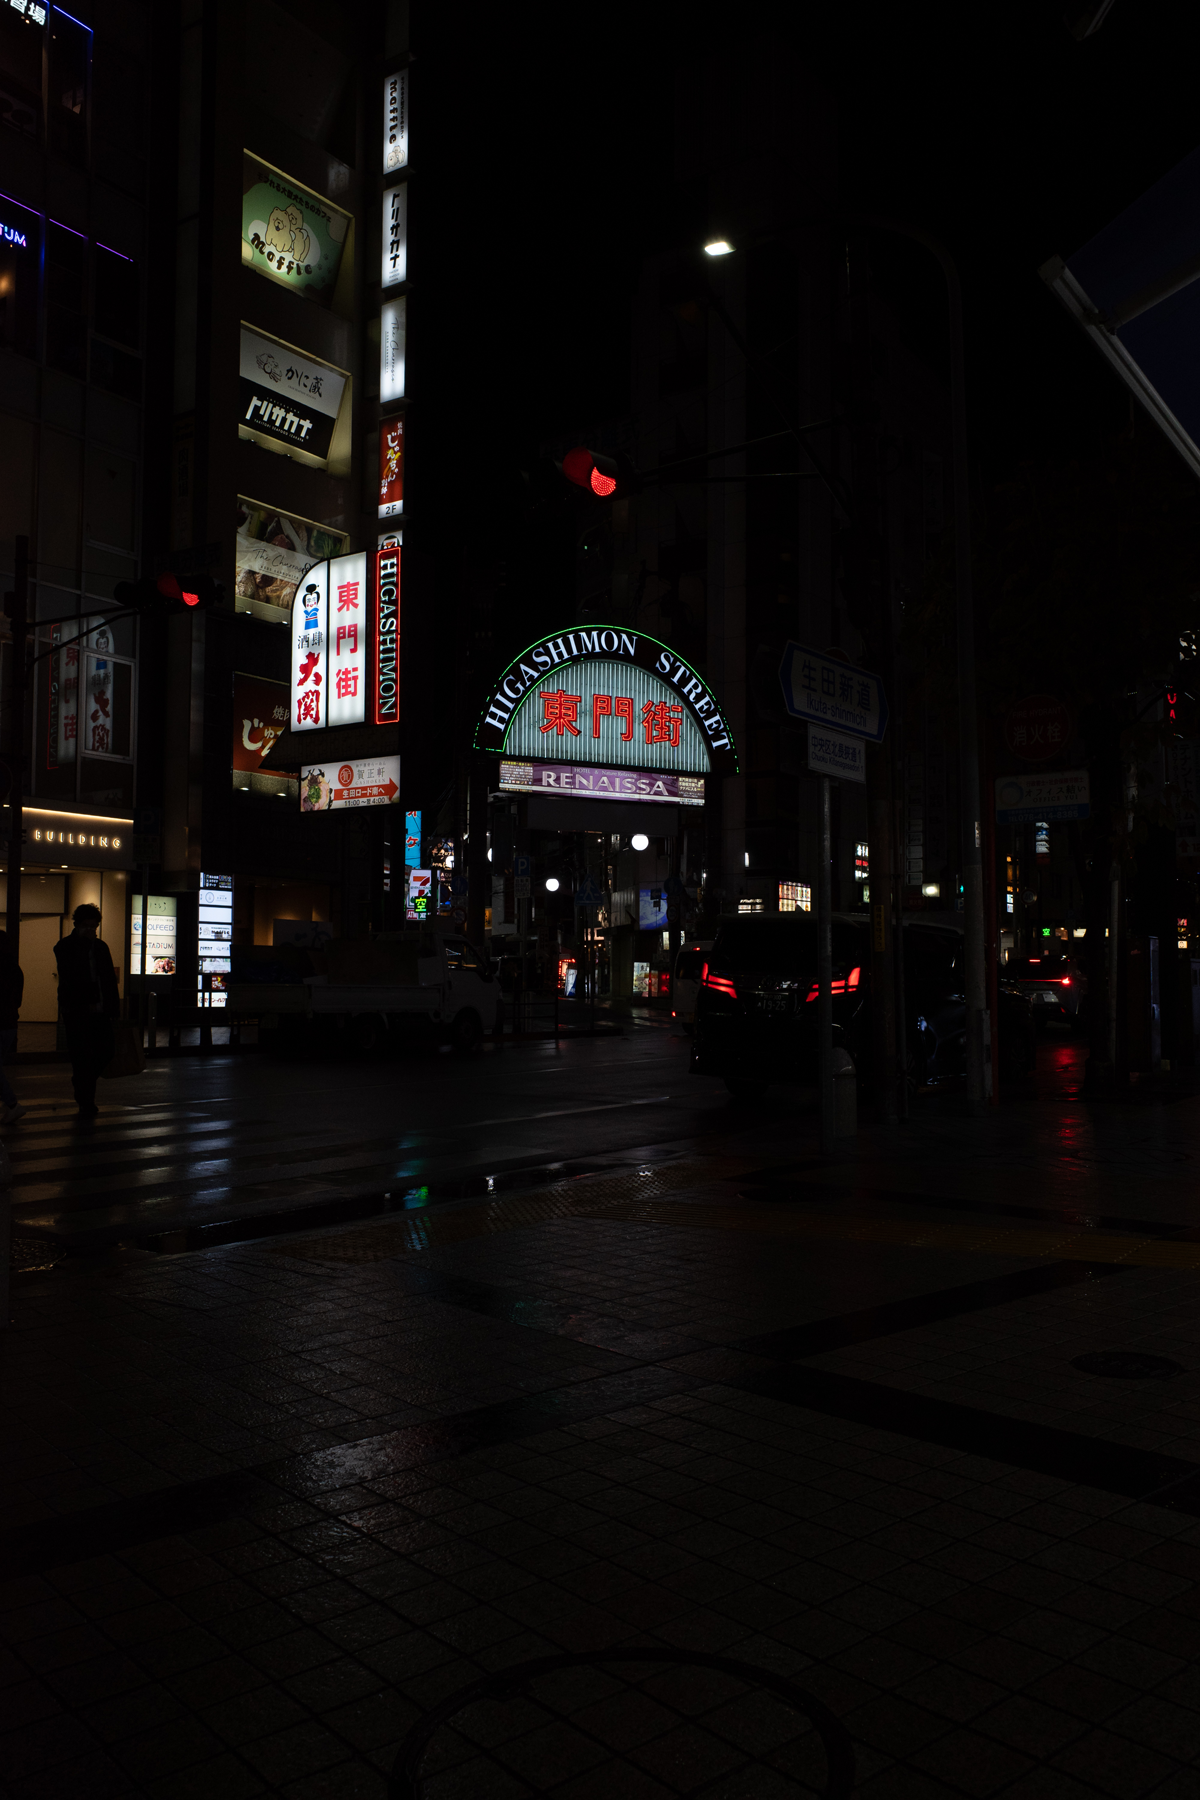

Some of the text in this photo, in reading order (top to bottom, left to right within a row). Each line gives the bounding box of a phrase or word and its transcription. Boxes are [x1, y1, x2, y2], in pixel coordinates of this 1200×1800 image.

[389, 192, 400, 269] トリサカナ
[250, 232, 313, 276] moffle
[285, 366, 324, 398] かに蔵
[245, 395, 313, 438] トリサカナ
[385, 505, 397, 515] 2F
[335, 580, 360, 699] 東門街
[379, 555, 397, 715] HIGASHIMON
[296, 651, 322, 726] 大関
[484, 629, 731, 751] HIGASHIMON STREET
[801, 659, 871, 712] 生田新道
[539, 689, 683, 748] 東門街
[806, 692, 867, 728] Ikuta-shinmichi
[1012, 706, 1062, 719] FIRE HYDRANT
[1012, 721, 1062, 747] 消火栓
[357, 767, 385, 780] 賀正軒
[541, 771, 669, 796] RENAISSA
[1179, 744, 1194, 820] テナントホム
[342, 787, 385, 799] 生田ロード南へ
[1024, 785, 1086, 798] オフィス結い
[1032, 796, 1060, 804] OFFICE
[35, 829, 121, 848] BUILDING
[415, 898, 427, 912] 空
[148, 922, 174, 932] OLFEED
[147, 940, 174, 949] TADIUM
